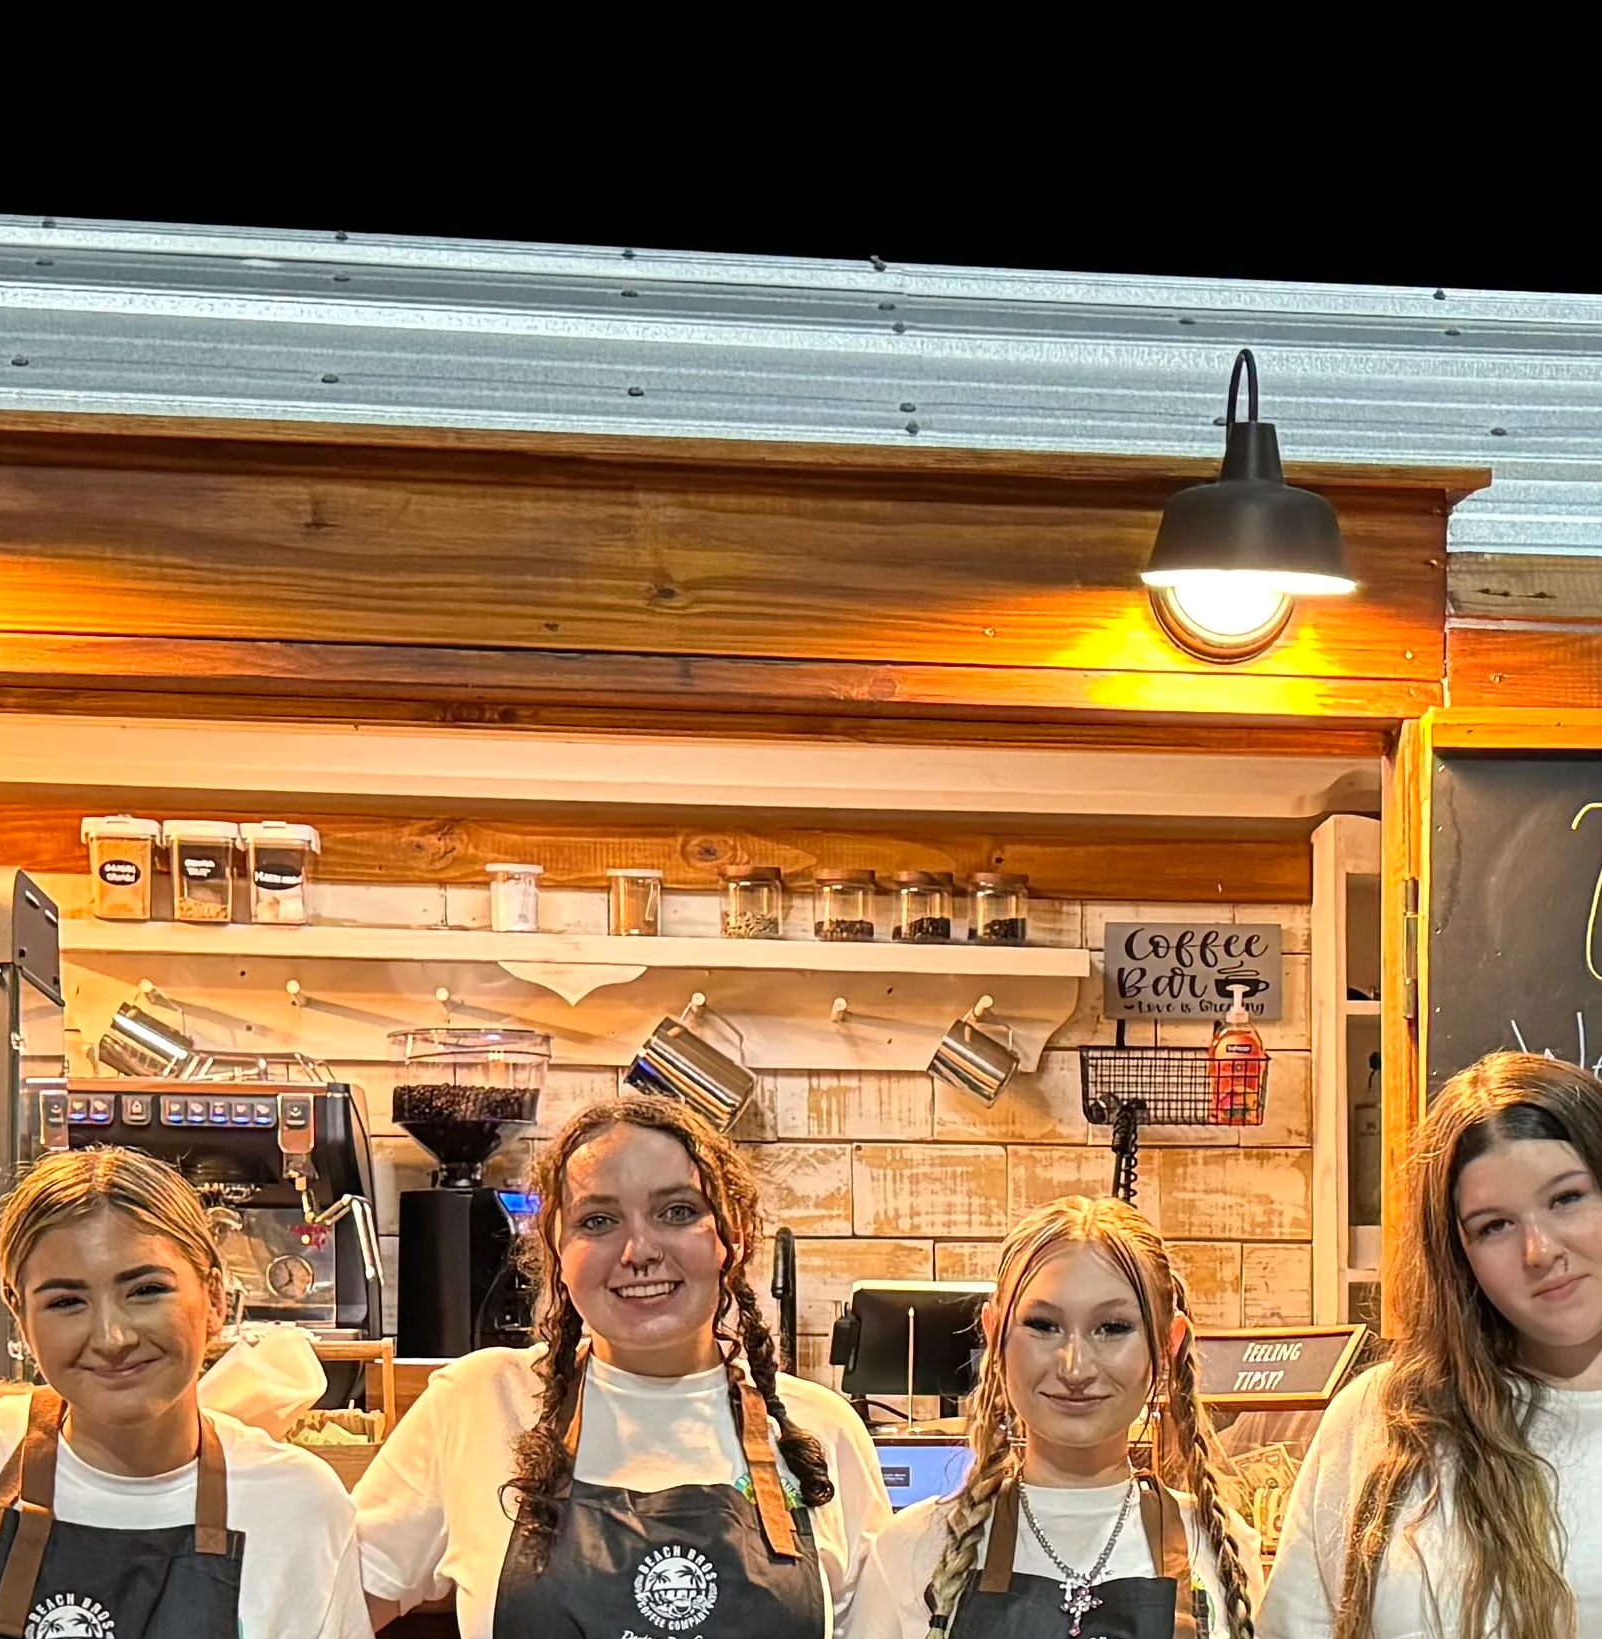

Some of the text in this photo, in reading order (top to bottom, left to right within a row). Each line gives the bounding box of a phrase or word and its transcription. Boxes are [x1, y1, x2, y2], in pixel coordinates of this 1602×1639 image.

[1124, 927, 1269, 968] Coffee
[1117, 967, 1208, 999] Bar
[1242, 1343, 1302, 1363] FEELING
[638, 1546, 718, 1580] BEACH BROS
[28, 1593, 115, 1629] BEACH BROS
[637, 1600, 715, 1631] COFFEE COMPANY
